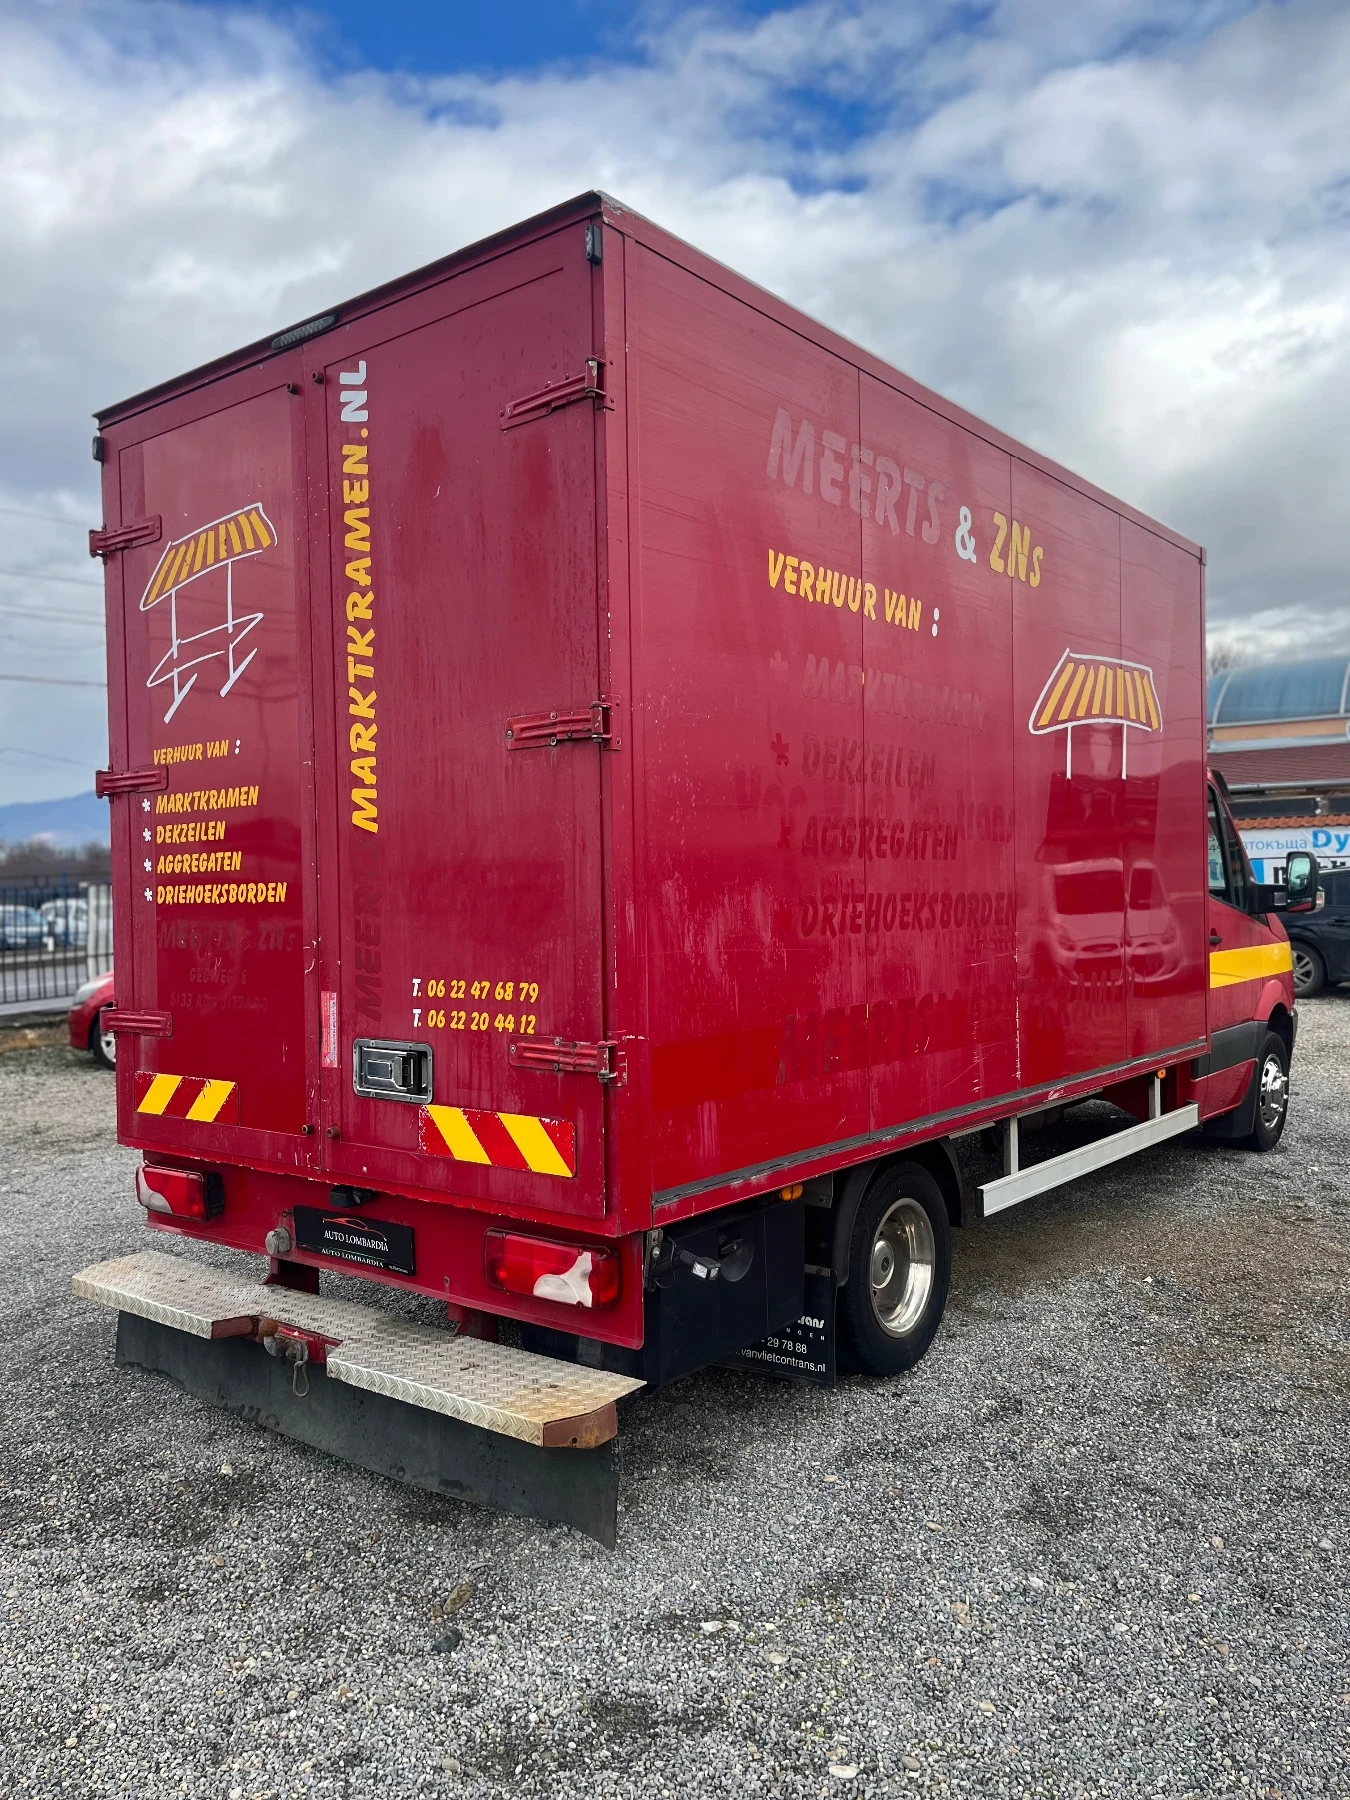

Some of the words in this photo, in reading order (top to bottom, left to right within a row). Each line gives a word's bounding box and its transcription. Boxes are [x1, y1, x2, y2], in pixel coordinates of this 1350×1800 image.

[766, 406, 945, 544] MEERTS
[955, 505, 977, 564] &
[768, 548, 877, 621] VERHUUR
[884, 588, 922, 632] VAN
[153, 742, 203, 765] VERHUUR
[206, 740, 229, 758] VAN
[155, 785, 259, 814] MARKTKRAMEN
[156, 821, 226, 845] DEKZEILEN
[156, 851, 242, 875] AGGREGATEN
[156, 882, 287, 905] DRIEHOEKSBORDEN
[412, 978, 422, 997] T.
[427, 979, 446, 998] 06
[450, 980, 467, 999] 22
[470, 981, 490, 1000] 47
[494, 982, 514, 1001] 68
[519, 983, 539, 1003] 79
[412, 1009, 422, 1028] T.
[427, 1009, 446, 1028] 06
[450, 1010, 467, 1030] 22
[470, 1012, 489, 1031] 20
[494, 1012, 515, 1032] 44
[519, 1014, 537, 1034] 12
[323, 1229, 345, 1243] AUTO
[345, 1234, 389, 1252] LOMBARDIA
[321, 1248, 341, 1258] AUTO
[341, 1252, 384, 1268] LOMBARDIA
[767, 1336, 779, 1348] 29
[781, 1339, 794, 1351] 78
[795, 1342, 808, 1354] 88
